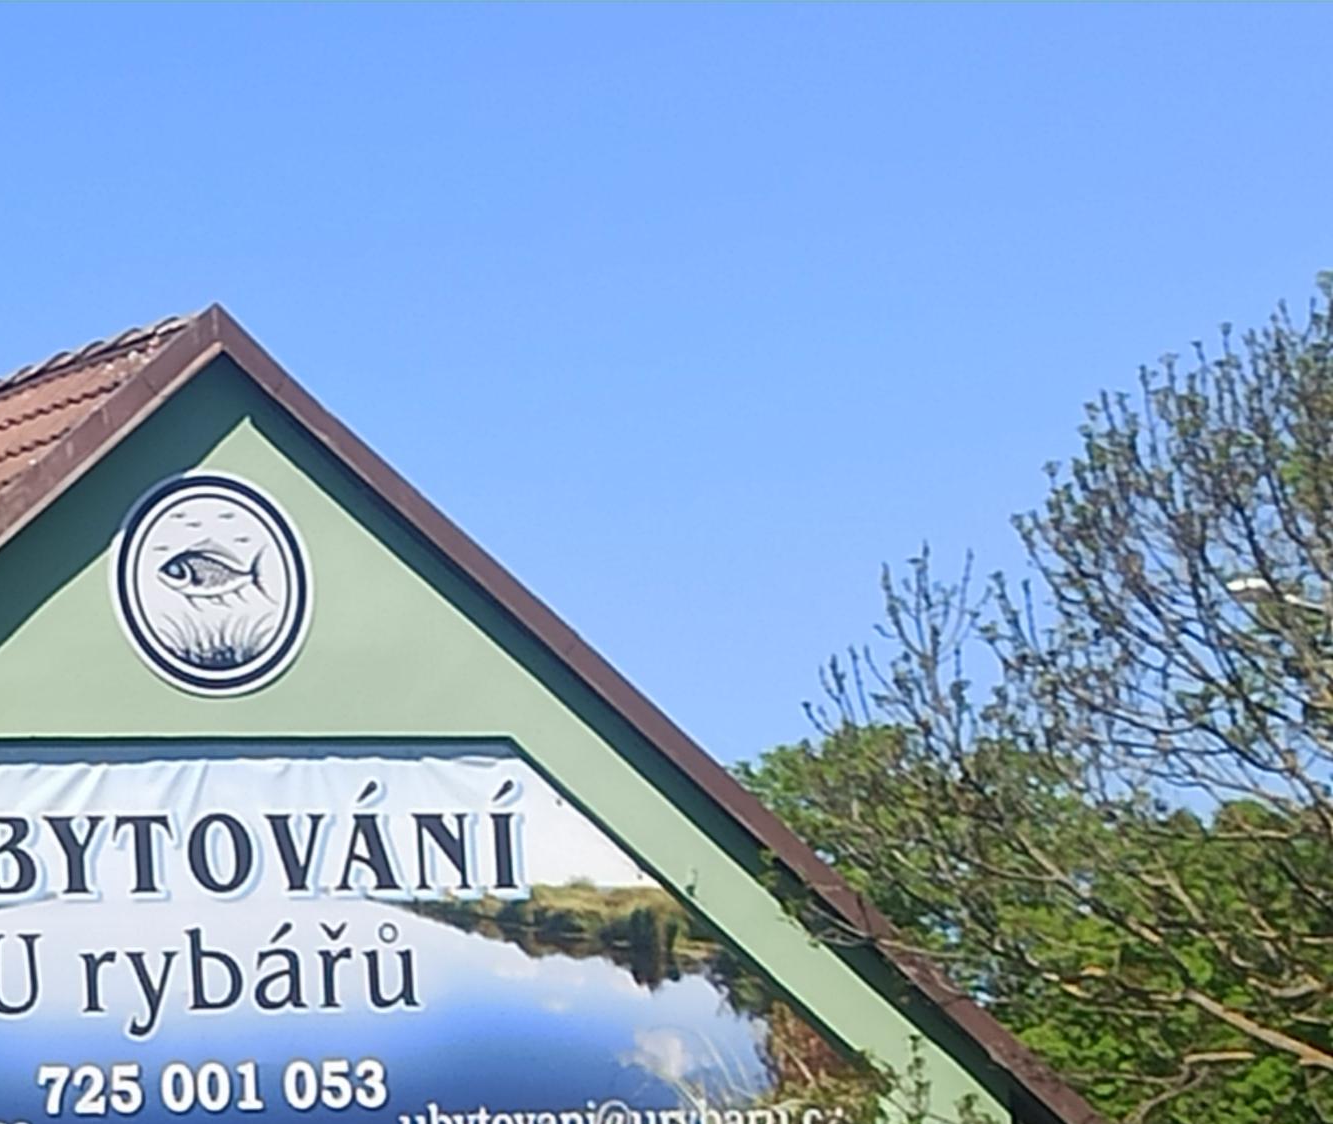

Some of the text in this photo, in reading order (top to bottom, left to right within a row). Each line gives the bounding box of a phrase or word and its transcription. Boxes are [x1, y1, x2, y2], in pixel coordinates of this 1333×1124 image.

[79, 922, 420, 1036] rybářů
[38, 1059, 387, 1114] 725 001 053
